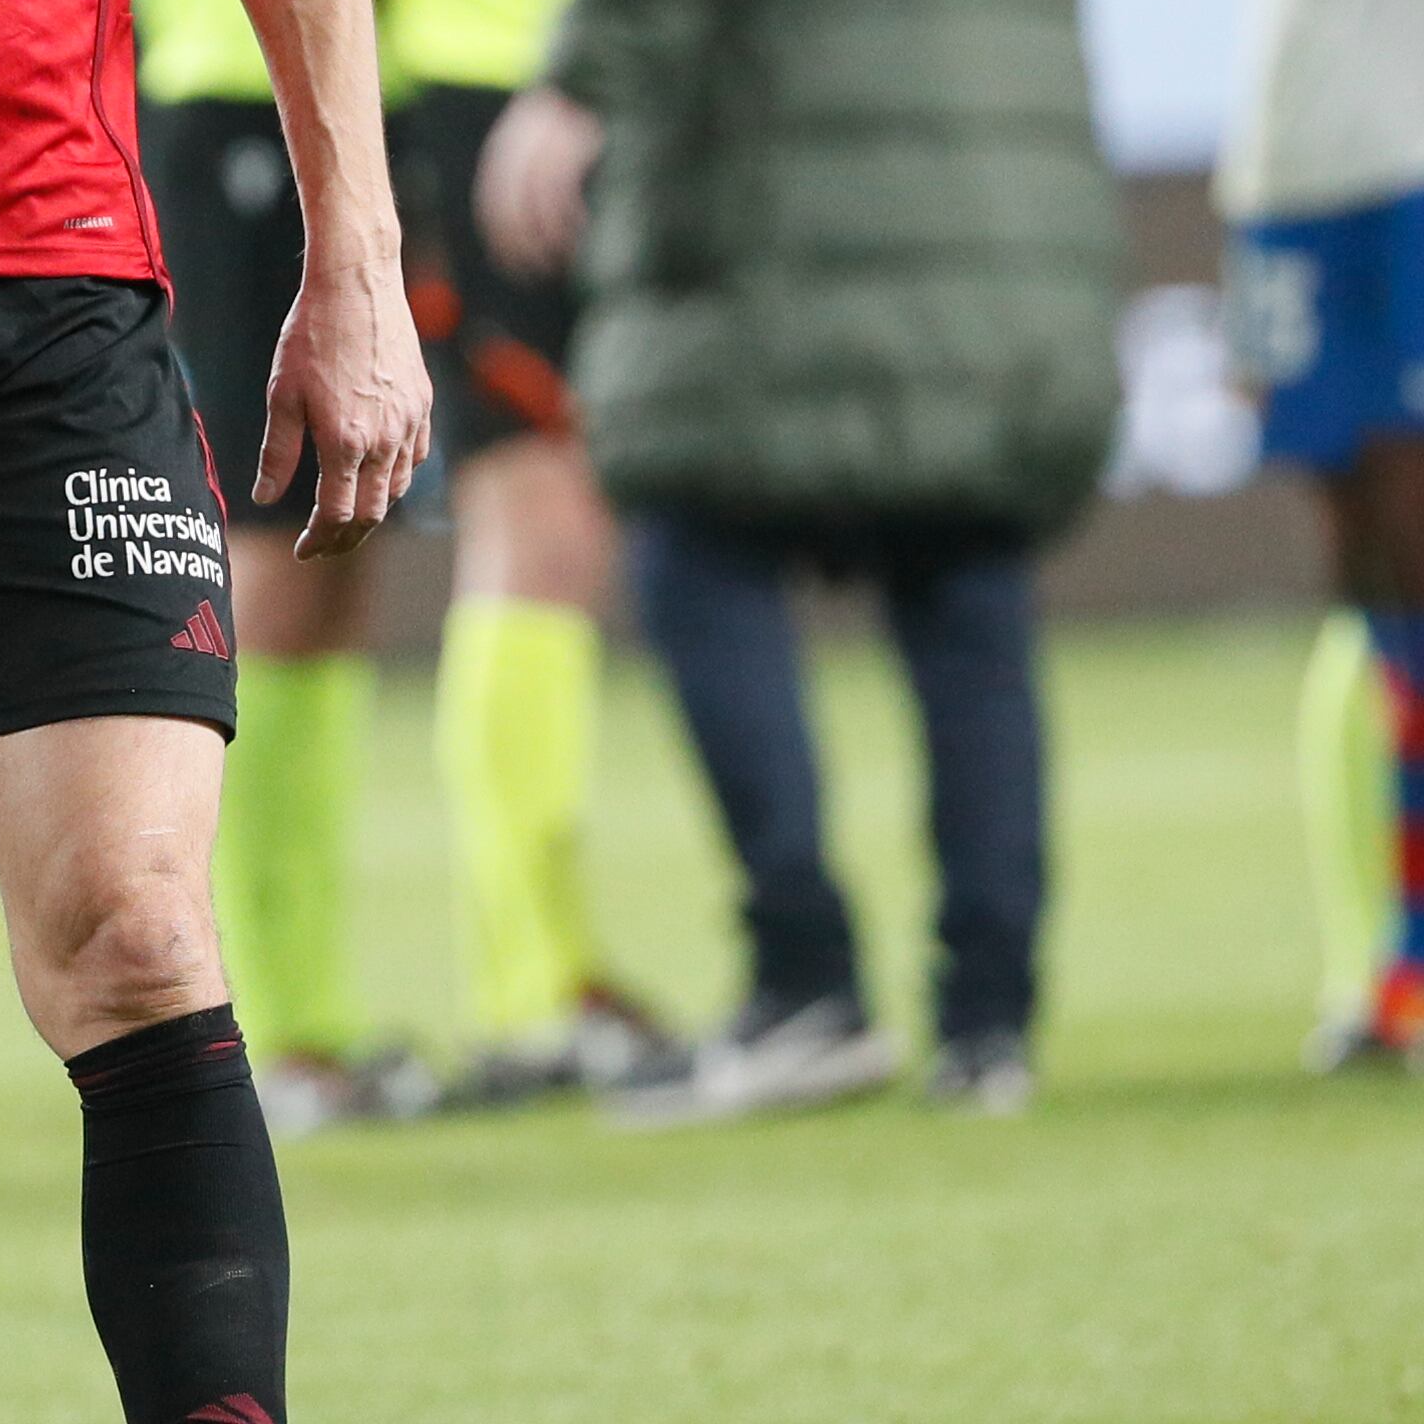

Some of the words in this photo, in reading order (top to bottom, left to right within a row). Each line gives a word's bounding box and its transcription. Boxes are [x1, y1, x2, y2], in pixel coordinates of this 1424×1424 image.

[64, 468, 172, 507] Clínica
[67, 504, 223, 556] Universidad
[70, 543, 115, 580] de
[124, 539, 225, 589] Navarra
